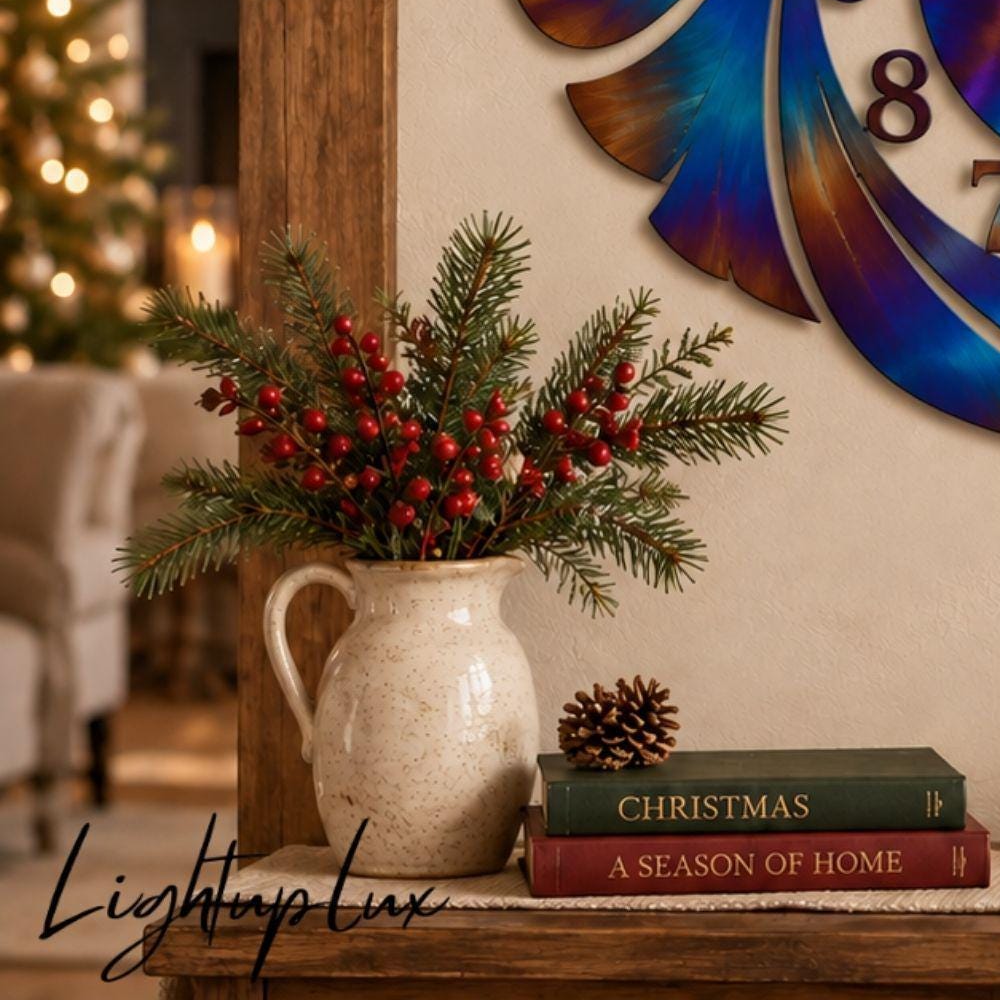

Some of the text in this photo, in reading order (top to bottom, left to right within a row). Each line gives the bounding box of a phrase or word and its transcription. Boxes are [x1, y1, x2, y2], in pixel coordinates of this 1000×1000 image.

[865, 49, 932, 143] 8
[618, 793, 811, 822] CHRISTMAS
[608, 849, 903, 879] A SEASON OF HOME
